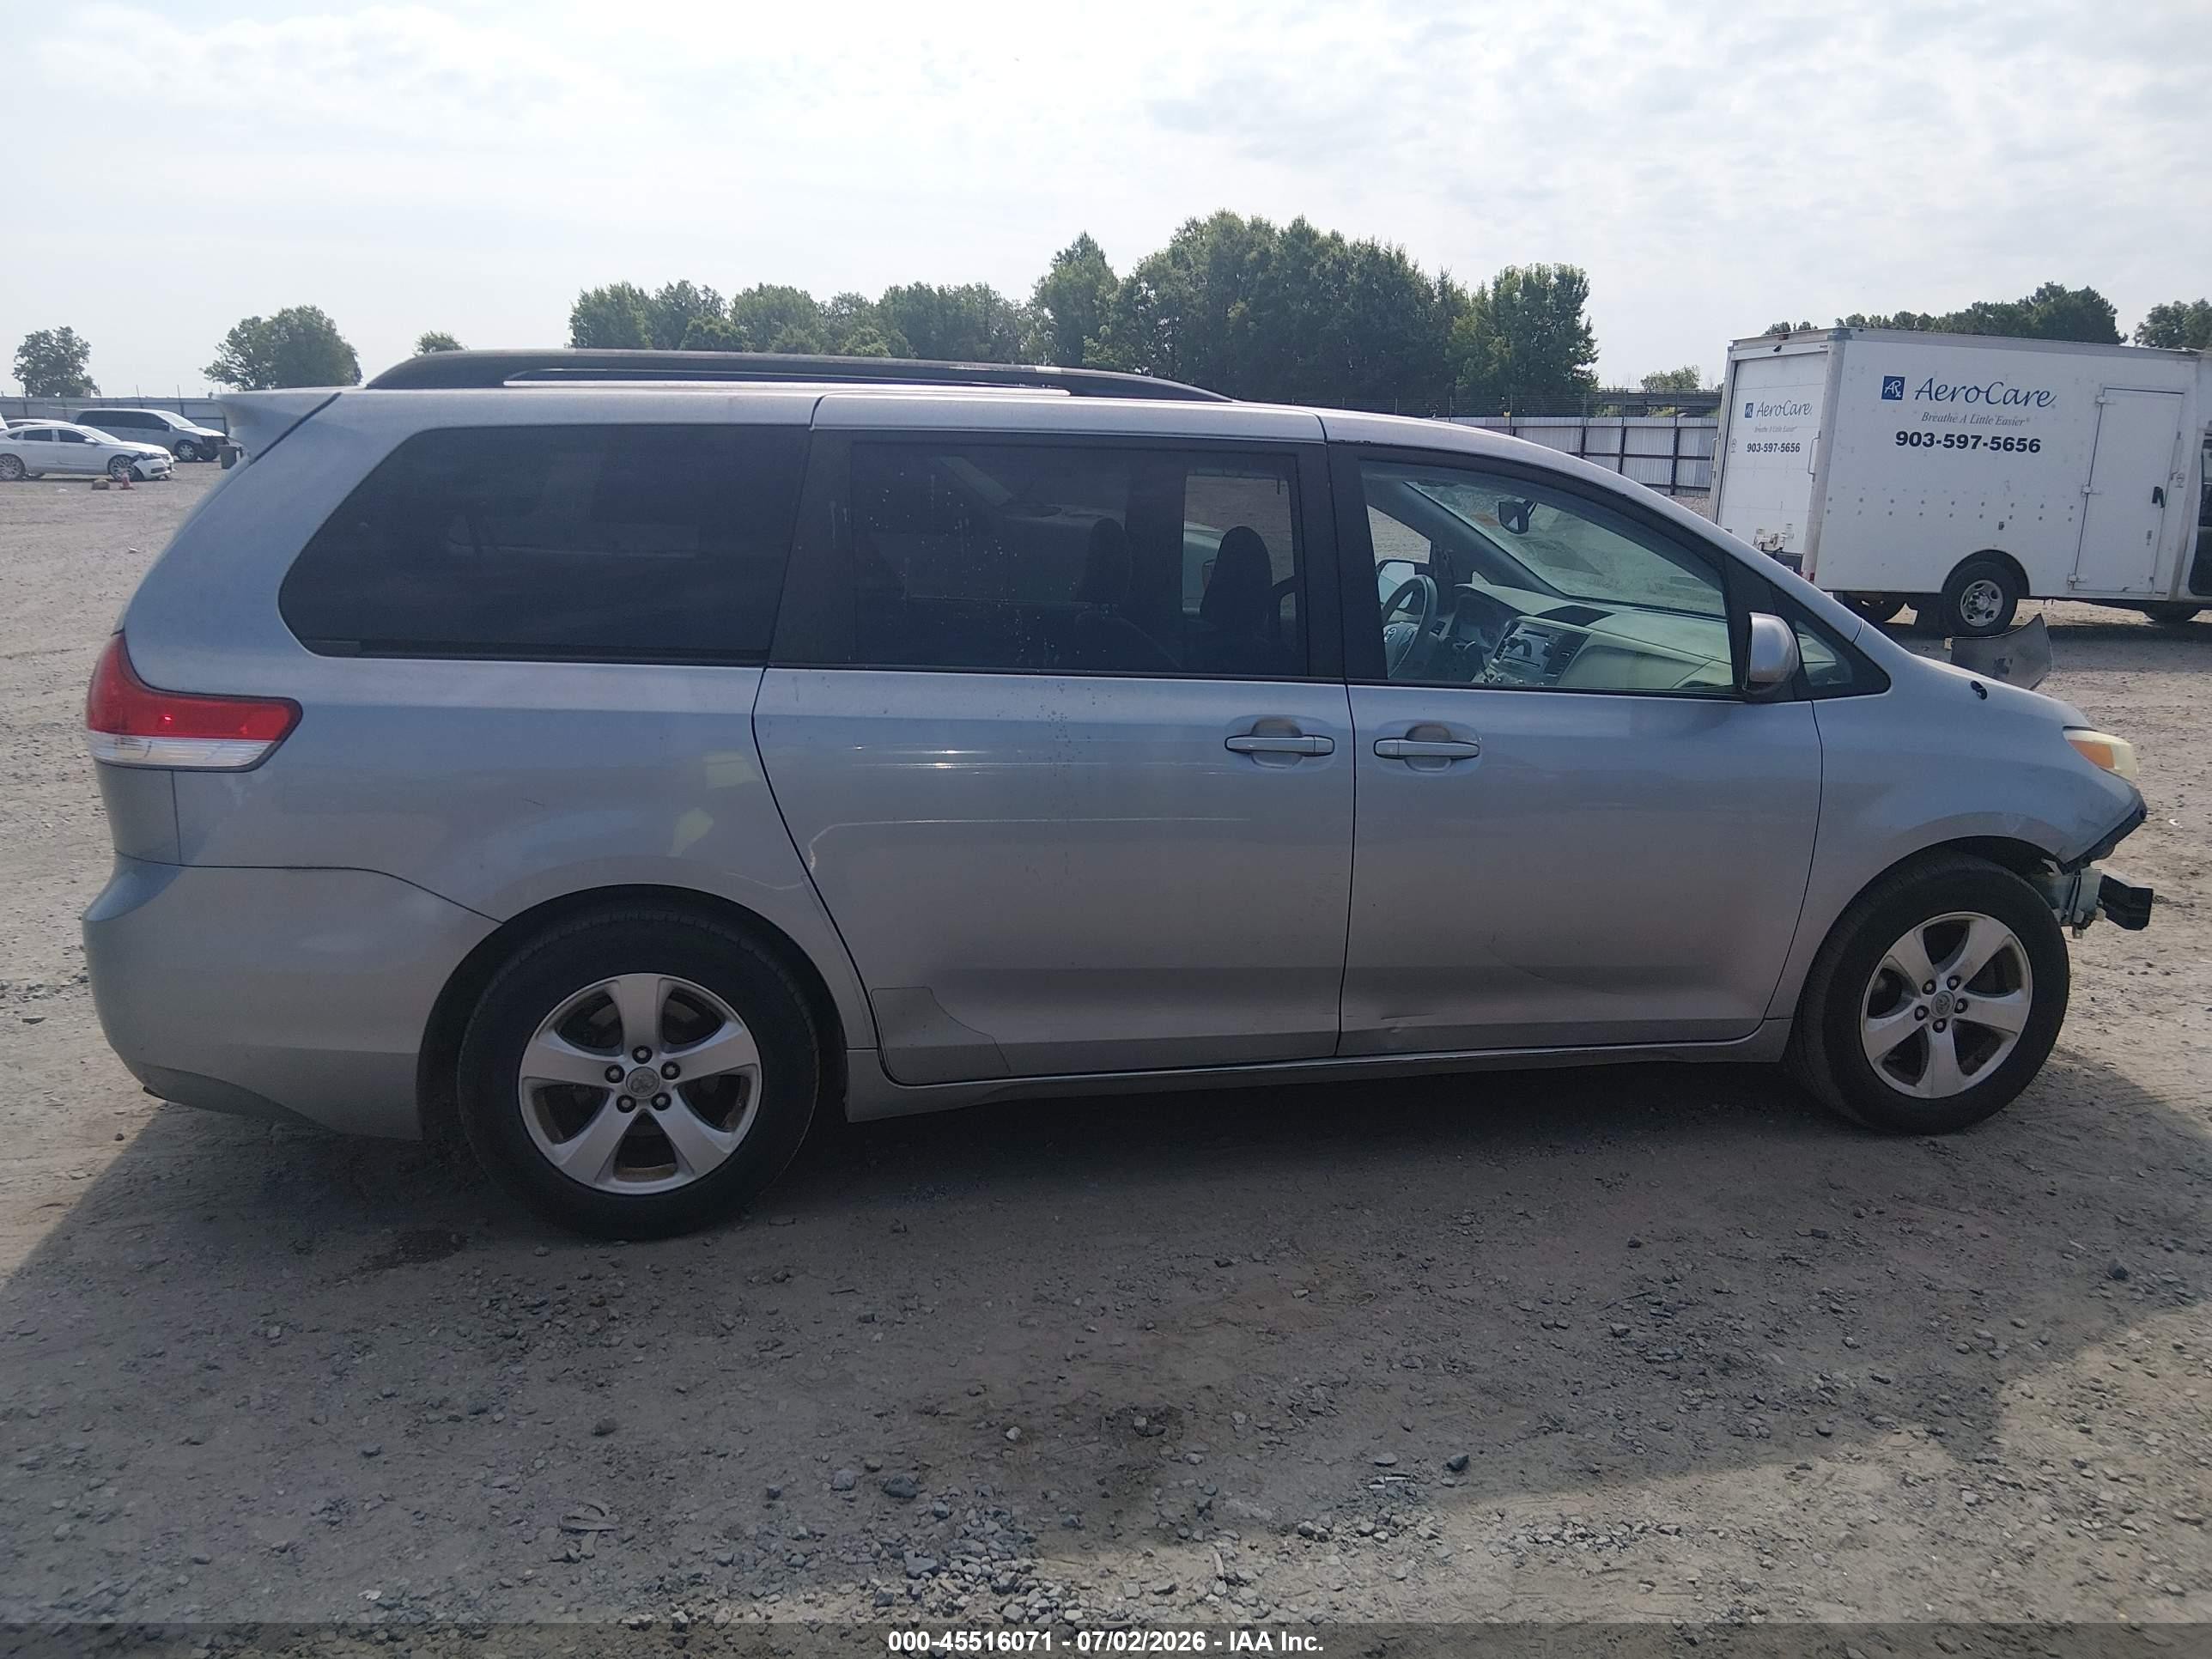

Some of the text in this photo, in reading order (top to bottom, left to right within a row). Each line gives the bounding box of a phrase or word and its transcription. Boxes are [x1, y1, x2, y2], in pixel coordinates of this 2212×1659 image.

[1914, 378, 2057, 408] AeroCare
[1756, 399, 1813, 417] AeroCare
[1921, 411, 1958, 423] Breathe
[1960, 414, 1967, 424] A
[1970, 414, 1993, 425] Little
[1747, 442, 1801, 453] 903-597-5656
[1895, 430, 2041, 453] 903-597-5656
